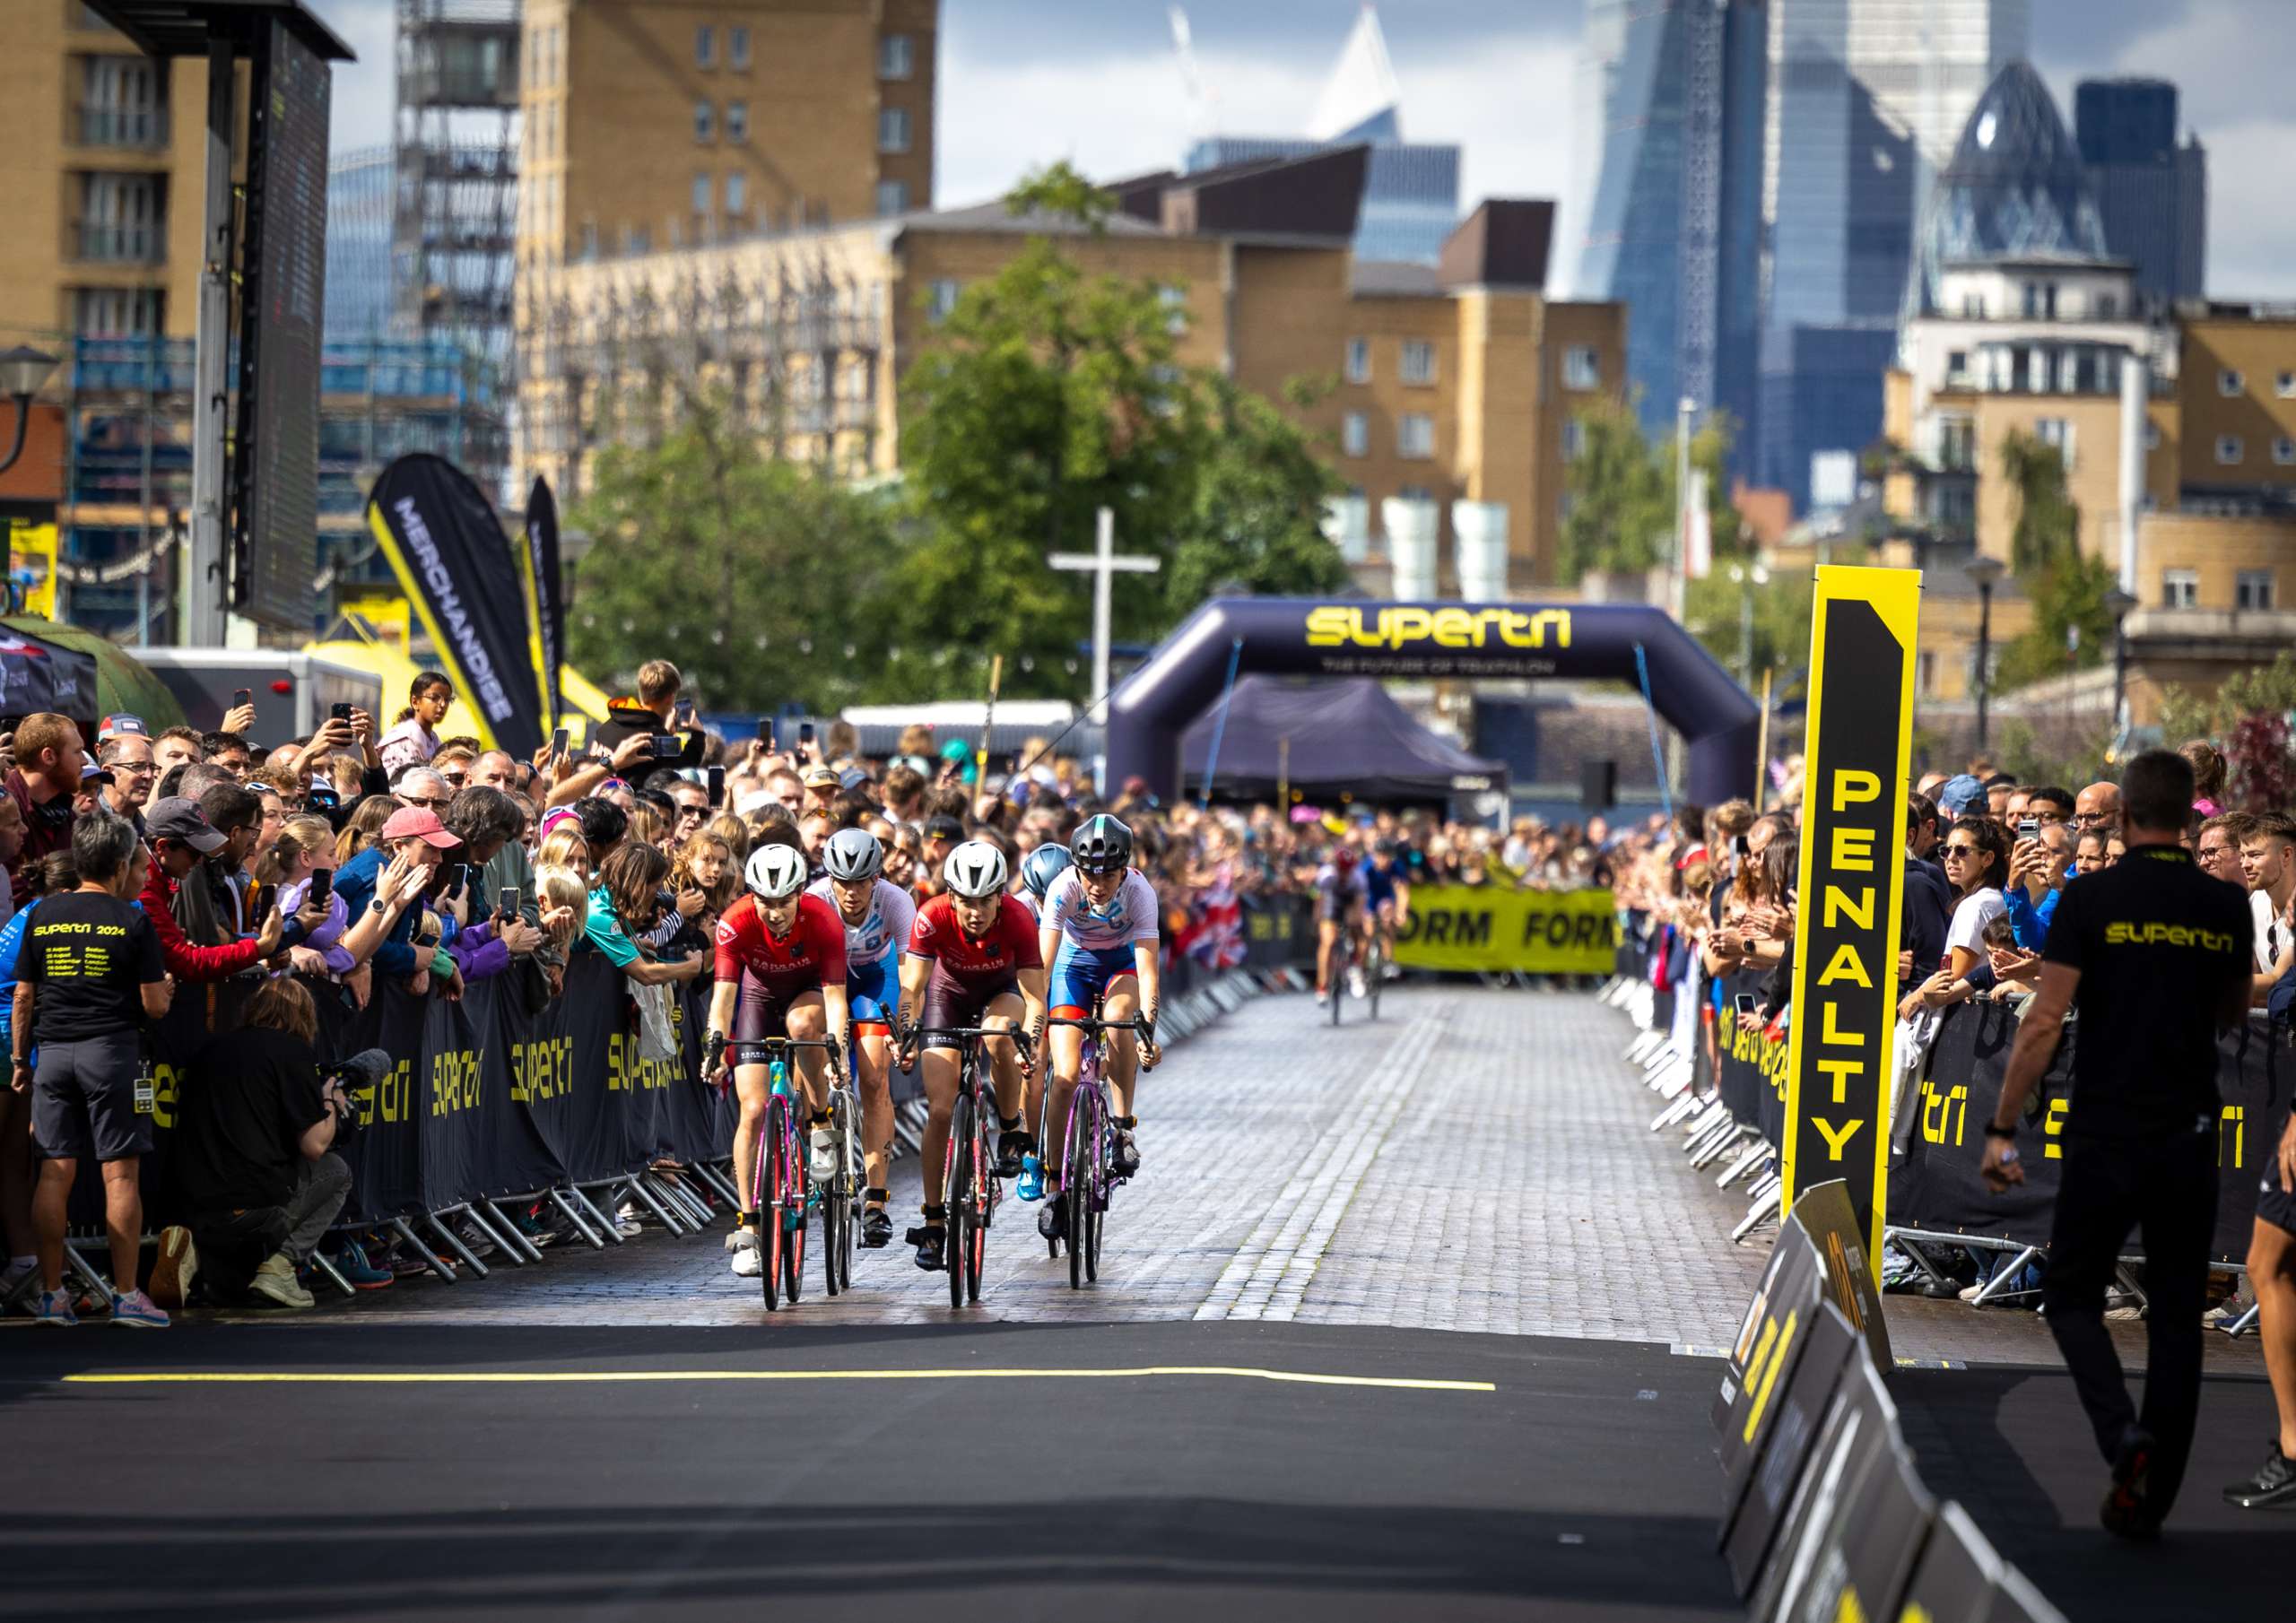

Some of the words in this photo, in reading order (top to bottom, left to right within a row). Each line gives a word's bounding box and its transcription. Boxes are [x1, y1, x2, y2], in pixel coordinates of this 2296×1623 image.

[394, 496, 513, 723] MERCHANDISE
[96, 925, 126, 935] 2024
[1396, 907, 1493, 947] ORM
[1811, 768, 1882, 1161] PENALTY
